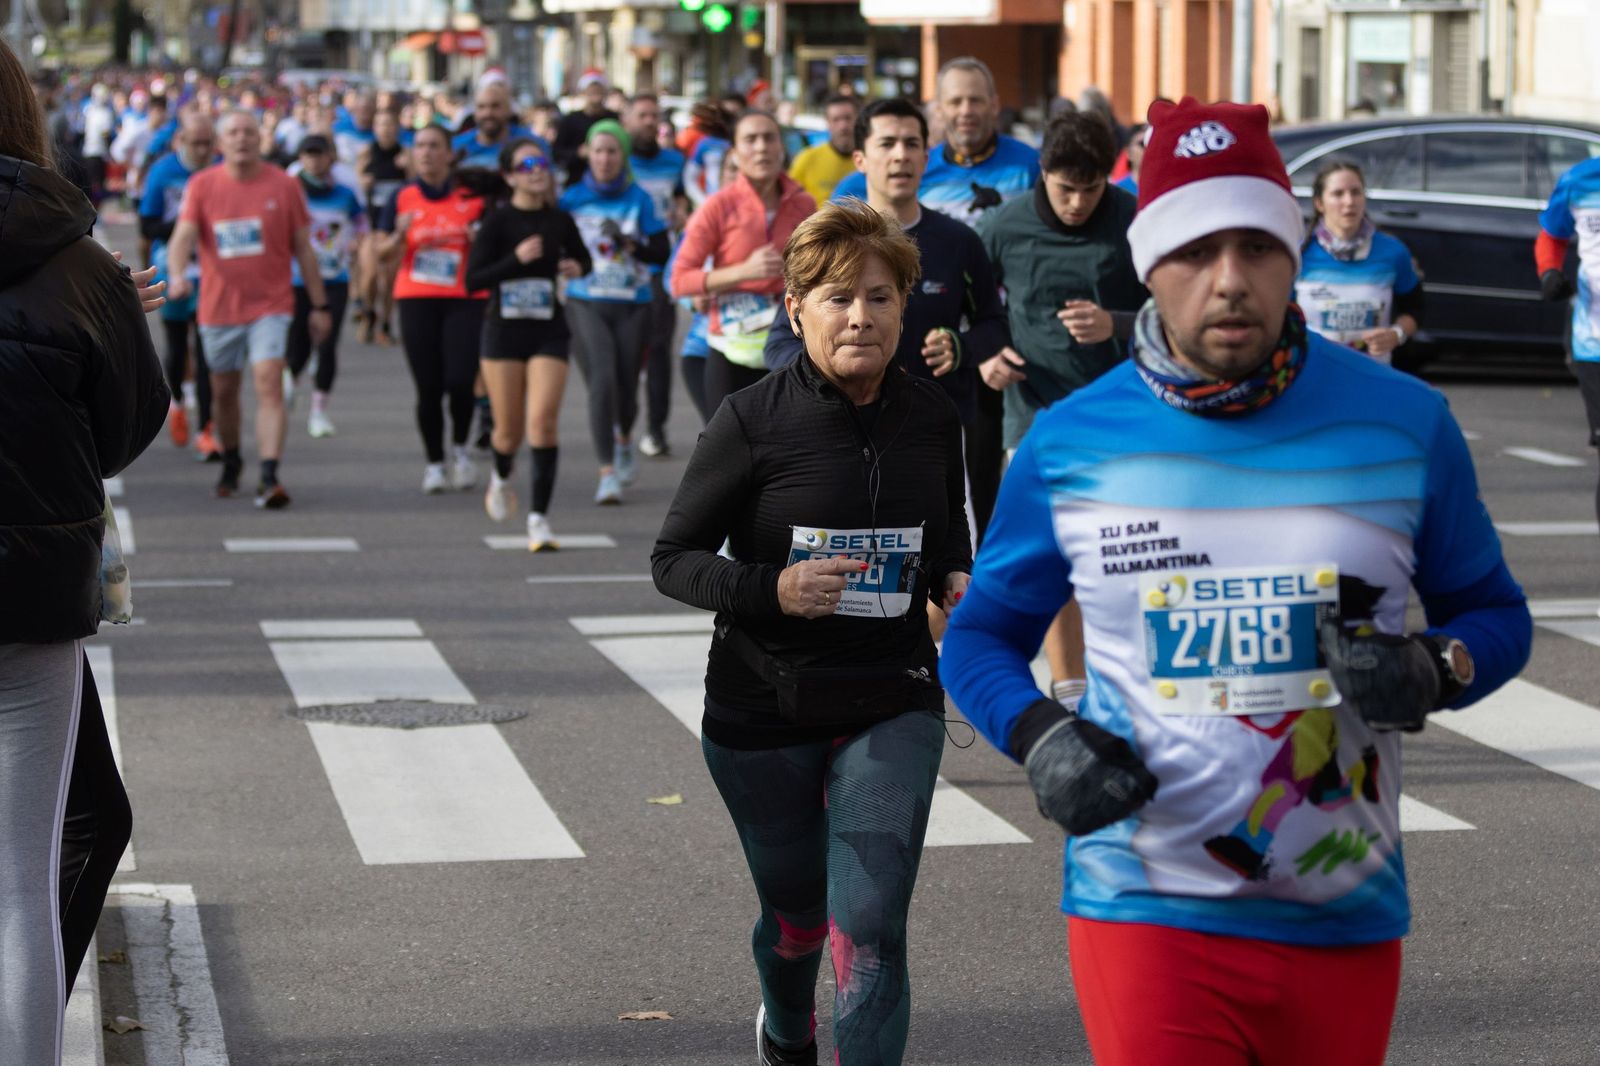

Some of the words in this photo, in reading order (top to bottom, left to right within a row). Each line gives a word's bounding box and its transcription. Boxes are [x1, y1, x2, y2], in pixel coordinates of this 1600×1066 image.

[1126, 520, 1160, 535] SAN
[829, 533, 910, 549] SETEL
[1101, 536, 1181, 557] SILVESTRE
[1103, 553, 1212, 576] SALMANTINA
[1194, 574, 1319, 602] SETEL
[844, 606, 872, 614] Salamanca
[1168, 605, 1293, 668] 2768
